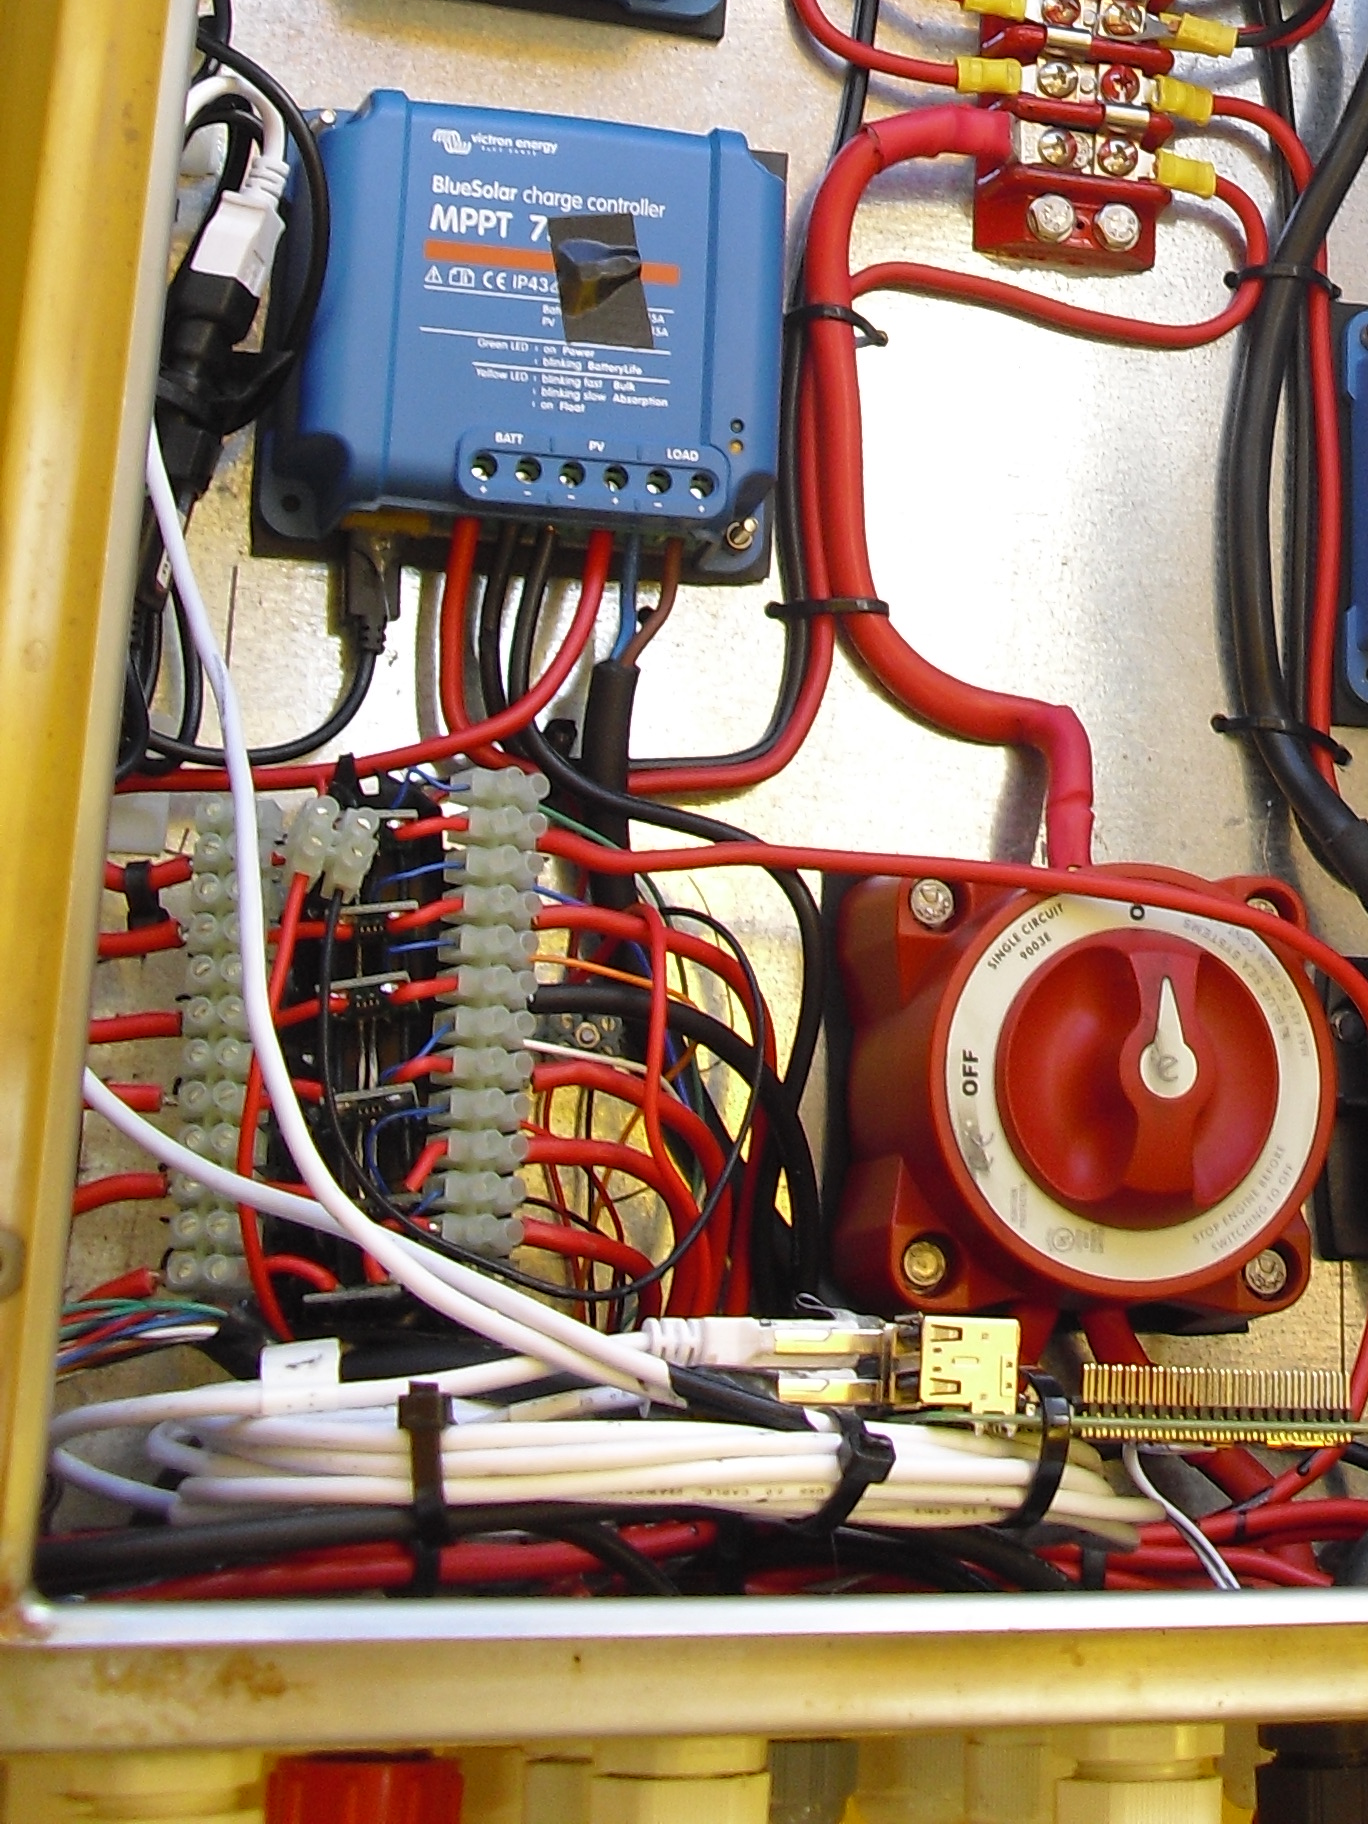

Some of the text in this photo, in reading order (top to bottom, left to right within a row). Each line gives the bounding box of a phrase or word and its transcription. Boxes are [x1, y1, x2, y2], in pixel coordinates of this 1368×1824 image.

[471, 132, 512, 147] victron
[514, 138, 558, 155] energy
[431, 174, 665, 218] BlueSolar charge controller
[429, 203, 551, 243] MPPT 7
[482, 270, 506, 290] CE
[510, 340, 529, 352] LED
[562, 346, 594, 358] Power
[542, 356, 642, 378] blinking BatteryLife
[509, 370, 528, 382] LED
[541, 372, 581, 389] blinking
[583, 376, 602, 389] fast
[612, 380, 635, 392] Bulk
[540, 385, 667, 408] blinking slow Absorption
[540, 401, 585, 413] on Float
[494, 431, 523, 445] BATT
[588, 440, 604, 453] PV
[666, 447, 698, 462] LOAD
[987, 902, 1064, 970] SINGLE CIRCUIT
[961, 1048, 979, 1097] OFF
[1193, 1144, 1286, 1244] STOP ENGINE BEFORE
[1211, 1204, 1268, 1253] SWITCHING
